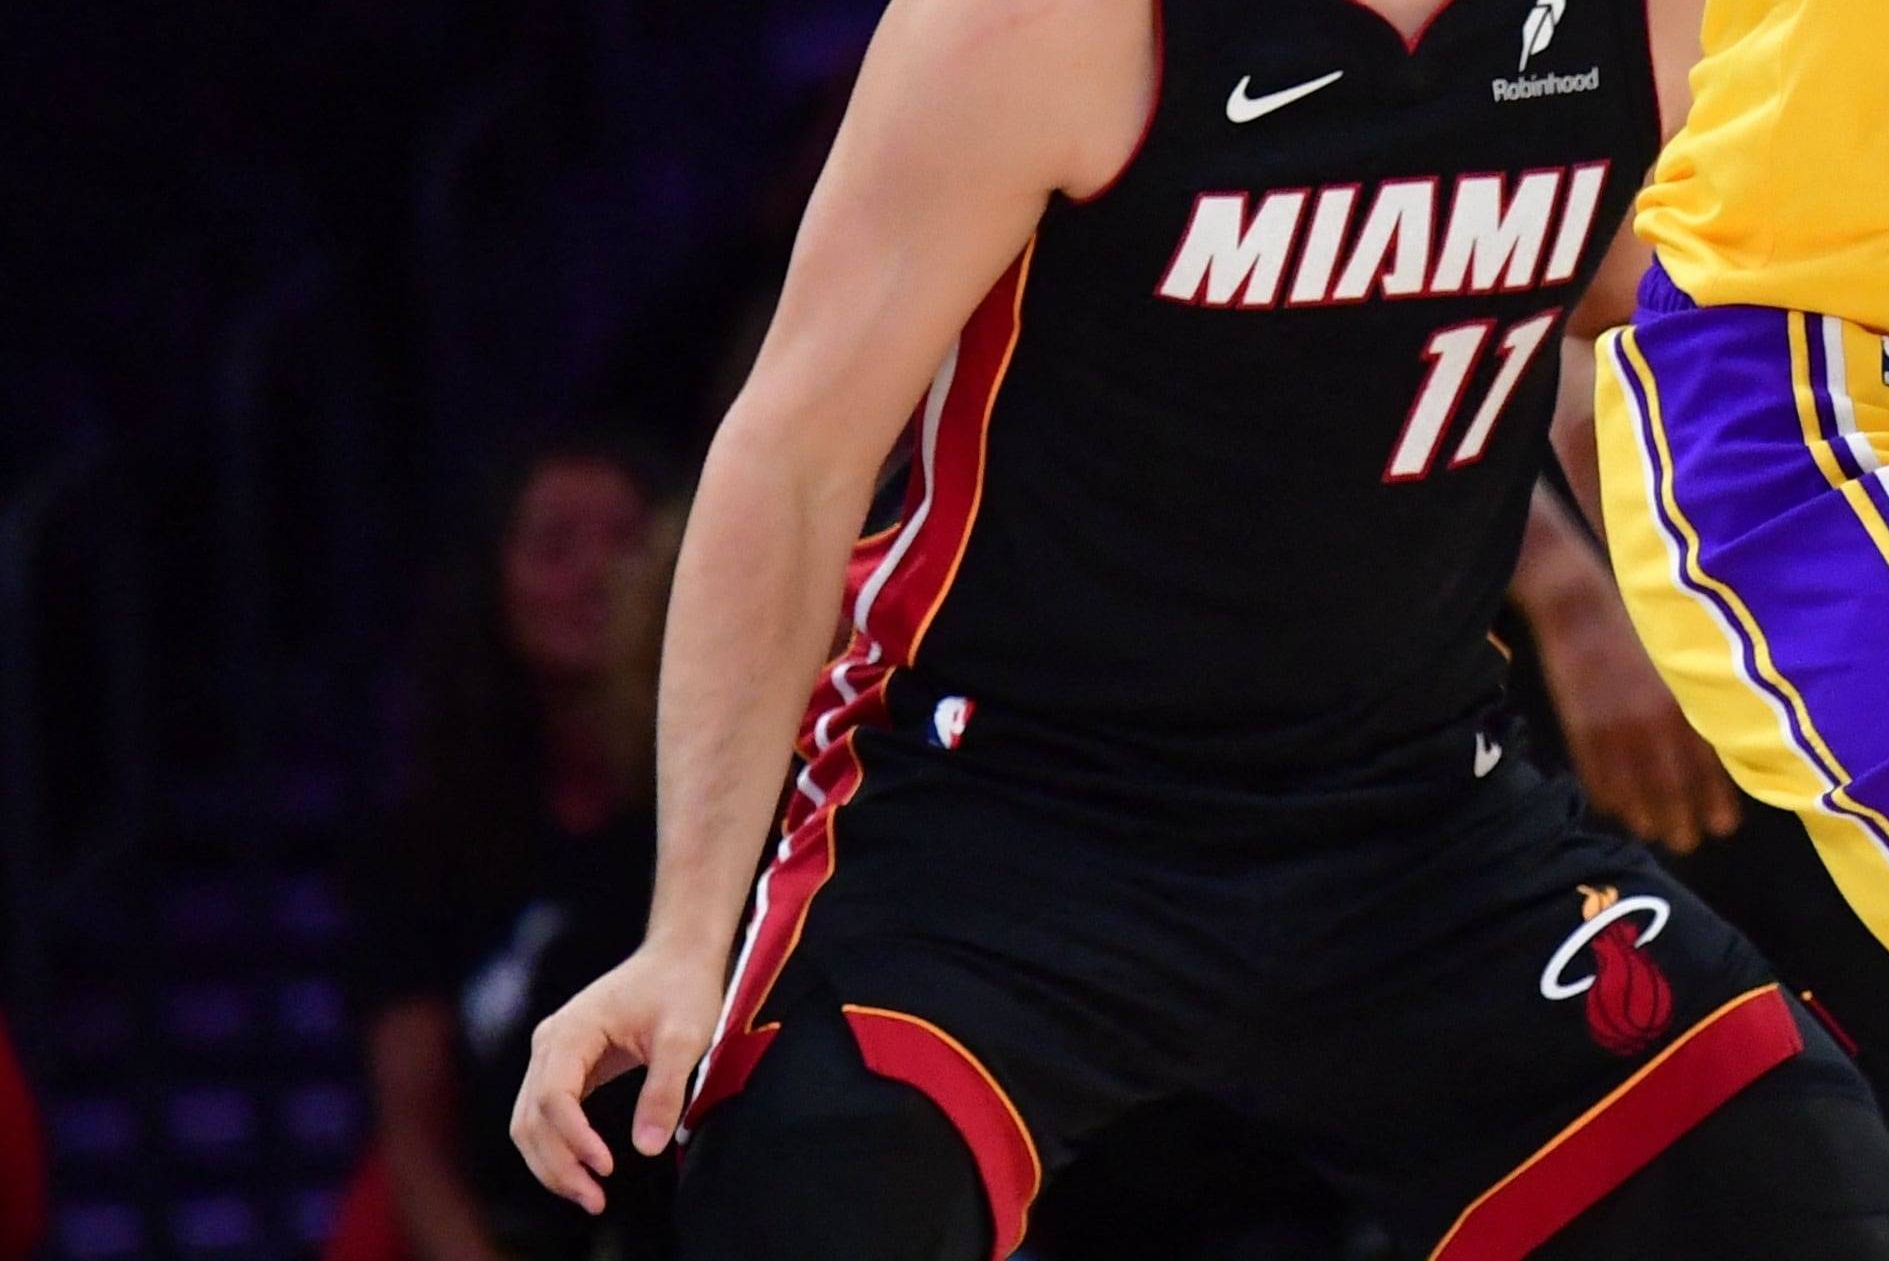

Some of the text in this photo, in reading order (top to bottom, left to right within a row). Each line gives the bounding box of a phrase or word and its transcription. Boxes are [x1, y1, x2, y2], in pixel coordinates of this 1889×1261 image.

[1492, 66, 1600, 102] Robinhood
[1153, 159, 1611, 309] MIAMI
[1382, 307, 1563, 483] 11
